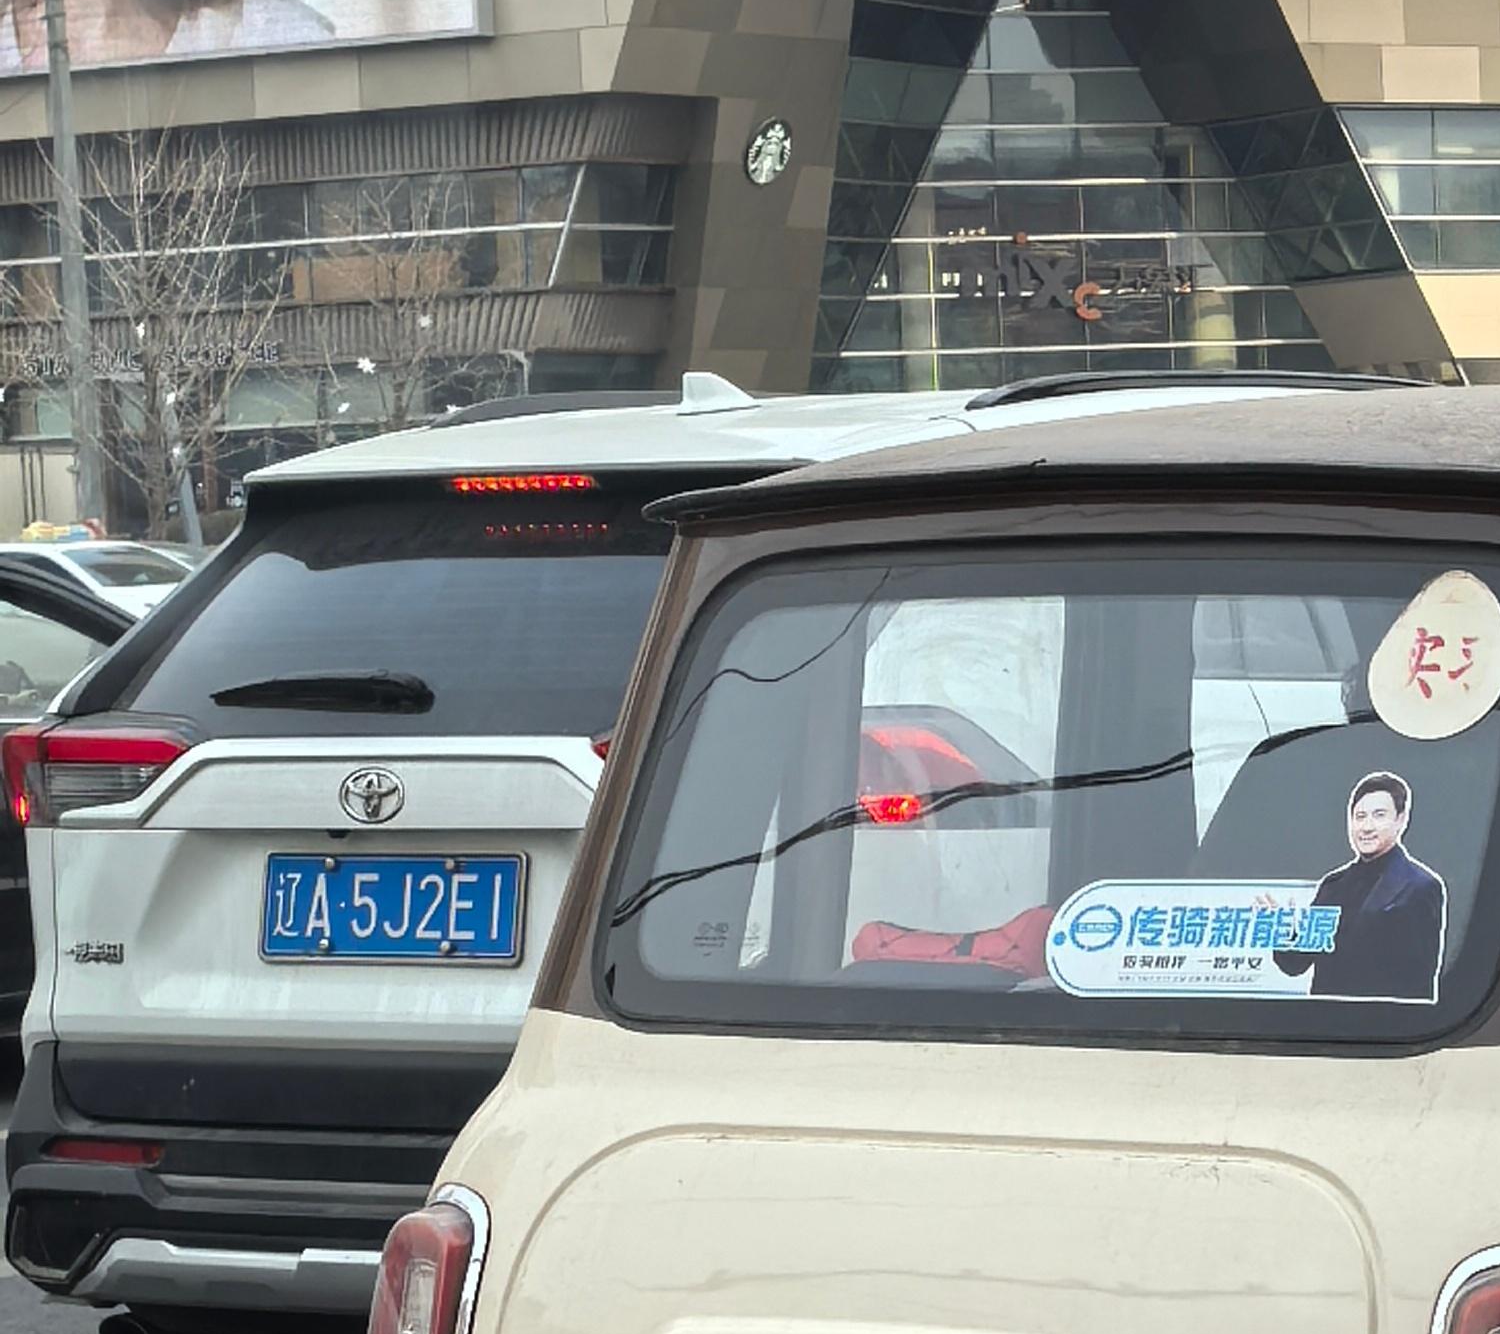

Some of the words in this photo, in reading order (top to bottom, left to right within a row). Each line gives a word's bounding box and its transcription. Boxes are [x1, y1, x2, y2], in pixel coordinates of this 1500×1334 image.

[1126, 905, 1341, 950] 传骑新能源
